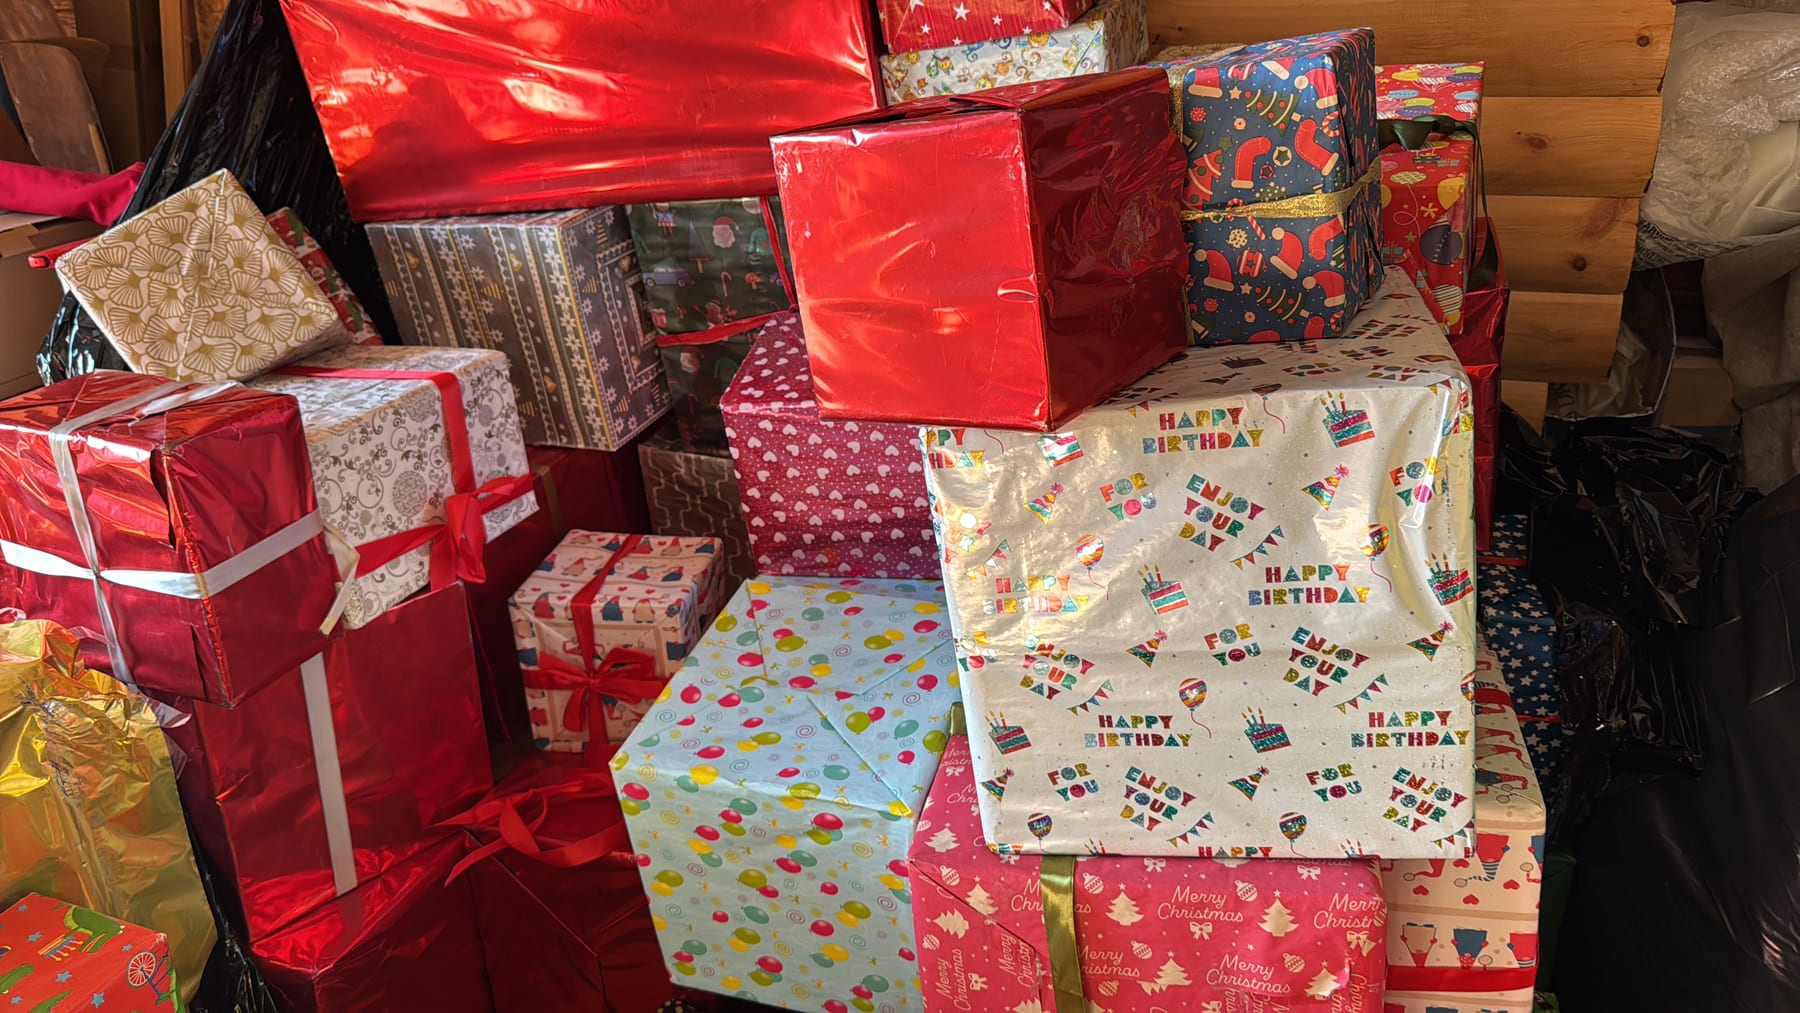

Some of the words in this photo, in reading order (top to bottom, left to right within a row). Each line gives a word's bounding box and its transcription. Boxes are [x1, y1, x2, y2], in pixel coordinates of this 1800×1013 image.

[1159, 407, 1243, 430] HAPPY
[1142, 429, 1264, 454] BIRTHDAY
[1100, 472, 1149, 502] FOR
[1185, 473, 1265, 521] ENJOY
[1108, 491, 1157, 521] YOU
[1184, 496, 1245, 538] YOUR
[1179, 522, 1226, 552] DAY
[996, 575, 1071, 594] HAPPY
[1265, 564, 1350, 583] HAPPY
[983, 595, 1089, 615] BIRTHDAY
[1248, 586, 1371, 606] BIRTHDAY
[1204, 624, 1254, 650] FOR
[1291, 626, 1371, 668] ENJOY
[1023, 634, 1095, 675] ENJOY
[1212, 642, 1261, 666] YOU
[1288, 647, 1349, 684] YOUR
[1022, 654, 1078, 691] YOUR
[1283, 667, 1330, 697] DAY
[1020, 674, 1061, 700] DAY
[1098, 715, 1173, 729] HAPPY
[1368, 711, 1452, 728] HAPPY
[1084, 733, 1192, 748] BIRTHDAY
[1351, 730, 1470, 748] BIRTHDAY
[1047, 763, 1091, 786] FOR
[1125, 766, 1197, 807] ENJOY
[1306, 763, 1355, 786] FOR
[1392, 767, 1468, 808] ENJOY
[1056, 779, 1099, 802] YOU
[1123, 784, 1178, 821] YOUR
[1313, 780, 1362, 802] YOU
[1389, 786, 1447, 823] YOUR
[1120, 804, 1162, 832] DAY
[1382, 806, 1428, 832] DAY
[1171, 885, 1226, 909] Merry
[1157, 902, 1244, 922] Christmas
[999, 933, 1017, 976] Merry
[1219, 953, 1274, 980] Merry
[936, 958, 951, 999] Merry
[951, 949, 971, 1011] Christmas
[1206, 968, 1291, 993] Christmas
